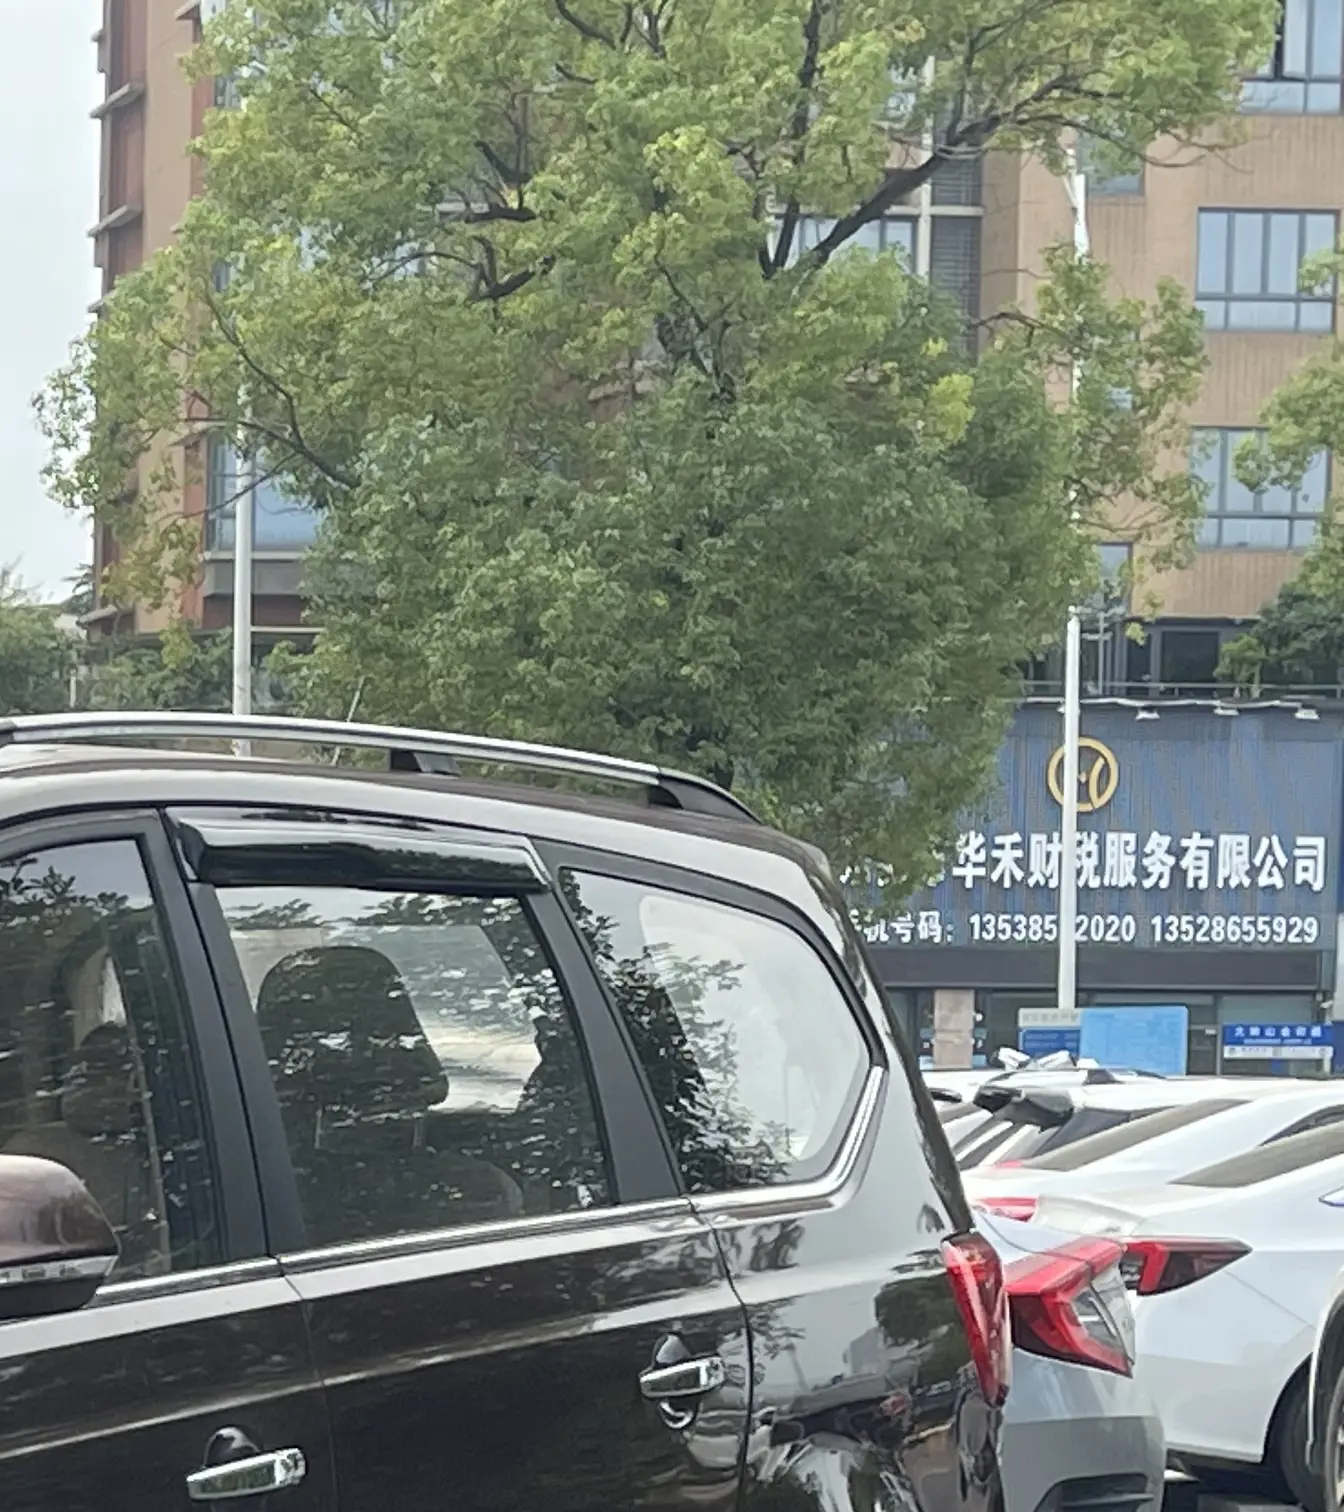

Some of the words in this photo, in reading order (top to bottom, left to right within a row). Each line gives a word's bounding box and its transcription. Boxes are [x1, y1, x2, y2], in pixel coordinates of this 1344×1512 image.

[839, 831, 1326, 891] 华禾财税服务有限公司
[969, 914, 1137, 943] 1353852020
[1150, 914, 1319, 943] 13528655929
